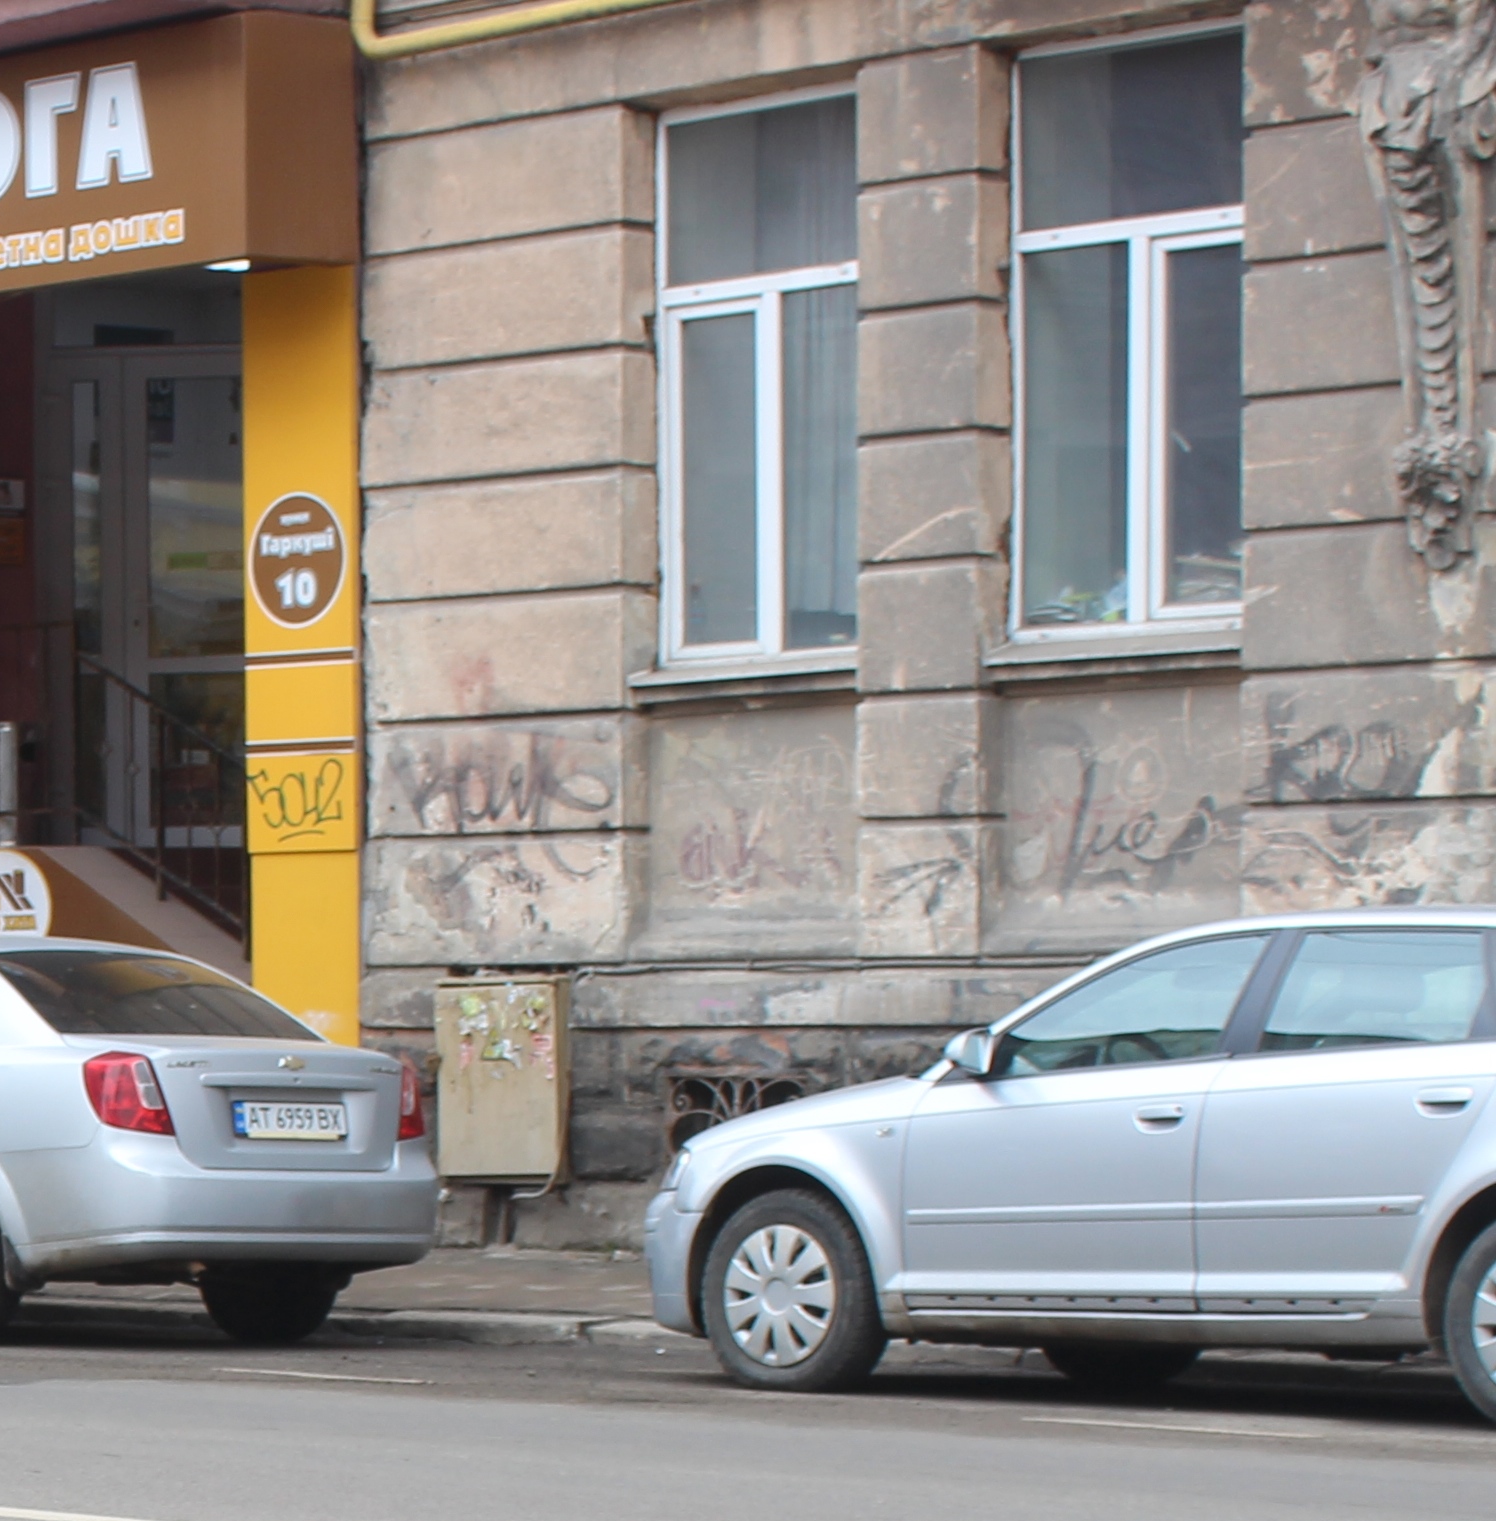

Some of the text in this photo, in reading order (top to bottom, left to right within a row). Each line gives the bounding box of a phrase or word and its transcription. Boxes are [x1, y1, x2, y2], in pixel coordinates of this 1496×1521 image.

[68, 208, 185, 262] дошка
[275, 567, 317, 610] 10
[248, 1106, 343, 1131] AT 6959 BX
